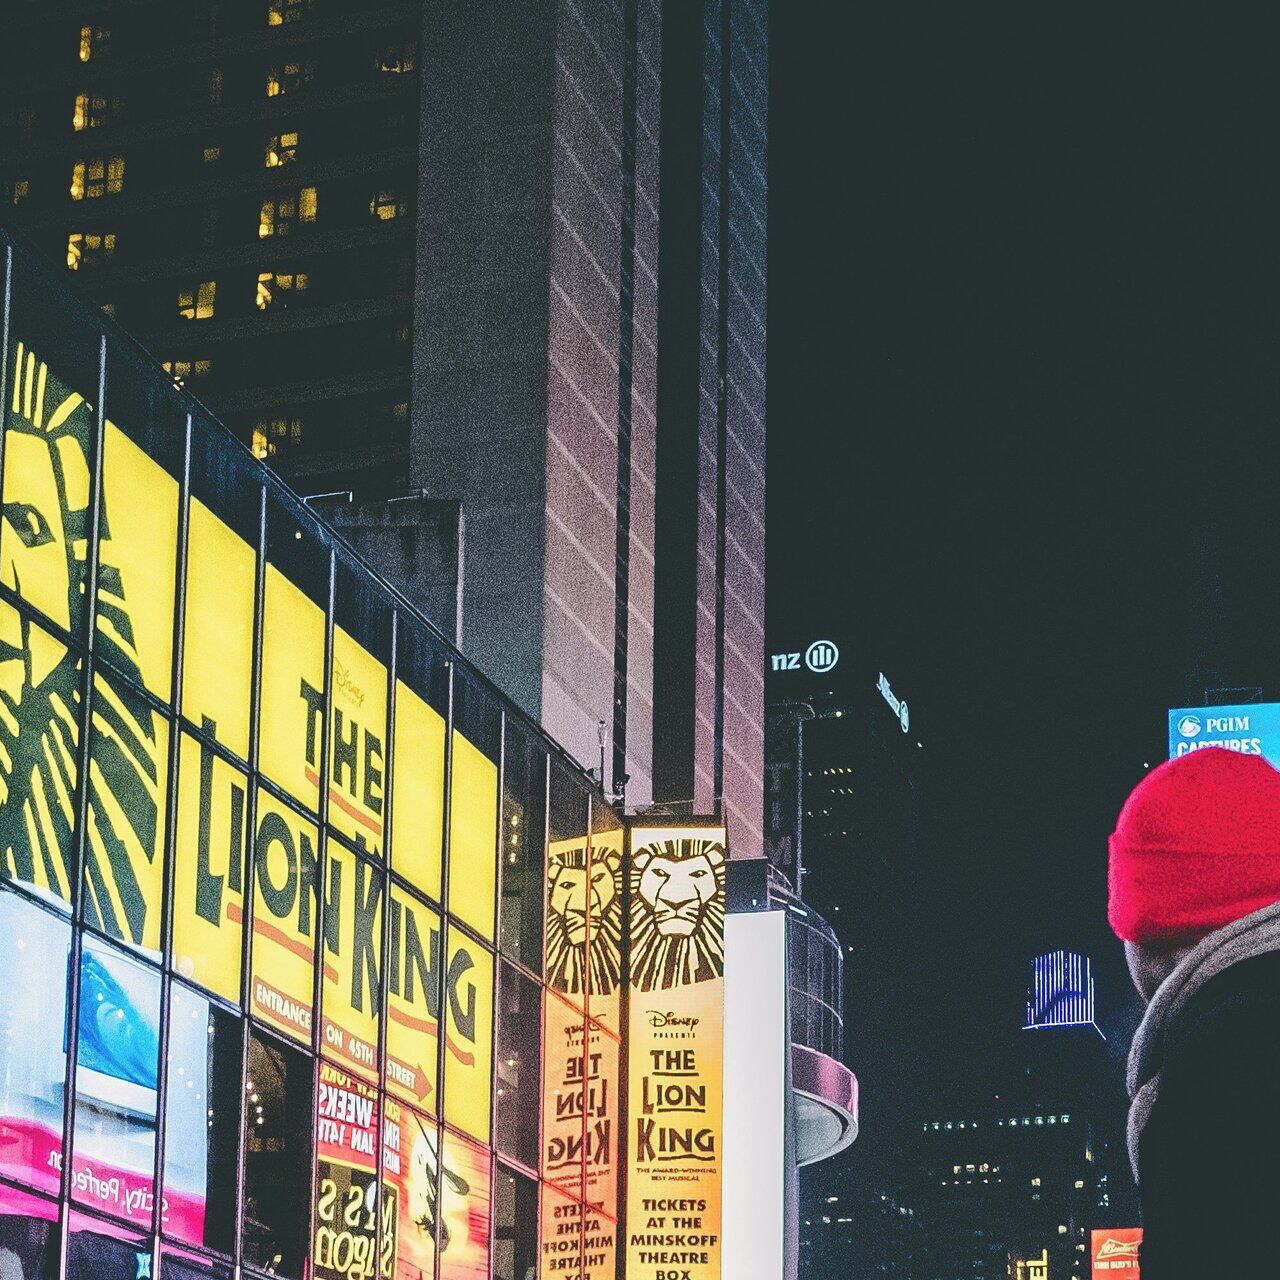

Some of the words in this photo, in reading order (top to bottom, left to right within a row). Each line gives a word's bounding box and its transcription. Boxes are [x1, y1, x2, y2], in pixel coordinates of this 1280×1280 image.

[1206, 716, 1250, 733] PGIM
[300, 678, 383, 817] THE
[196, 713, 342, 958] LION
[350, 826, 477, 1045] KING
[645, 1010, 699, 1031] Disney
[256, 984, 311, 1030] ENTRANCE
[326, 1024, 342, 1048] ON
[348, 1038, 374, 1065] 45TH
[387, 1059, 416, 1090] STREET
[650, 1049, 696, 1071] THE
[642, 1076, 706, 1115] LION
[637, 1118, 715, 1162] KING
[642, 1199, 706, 1211] TICKETS
[646, 1217, 666, 1228] AT
[672, 1217, 702, 1228] THE
[630, 1235, 717, 1247] MINSKOFF
[639, 1252, 708, 1264] THEATRE
